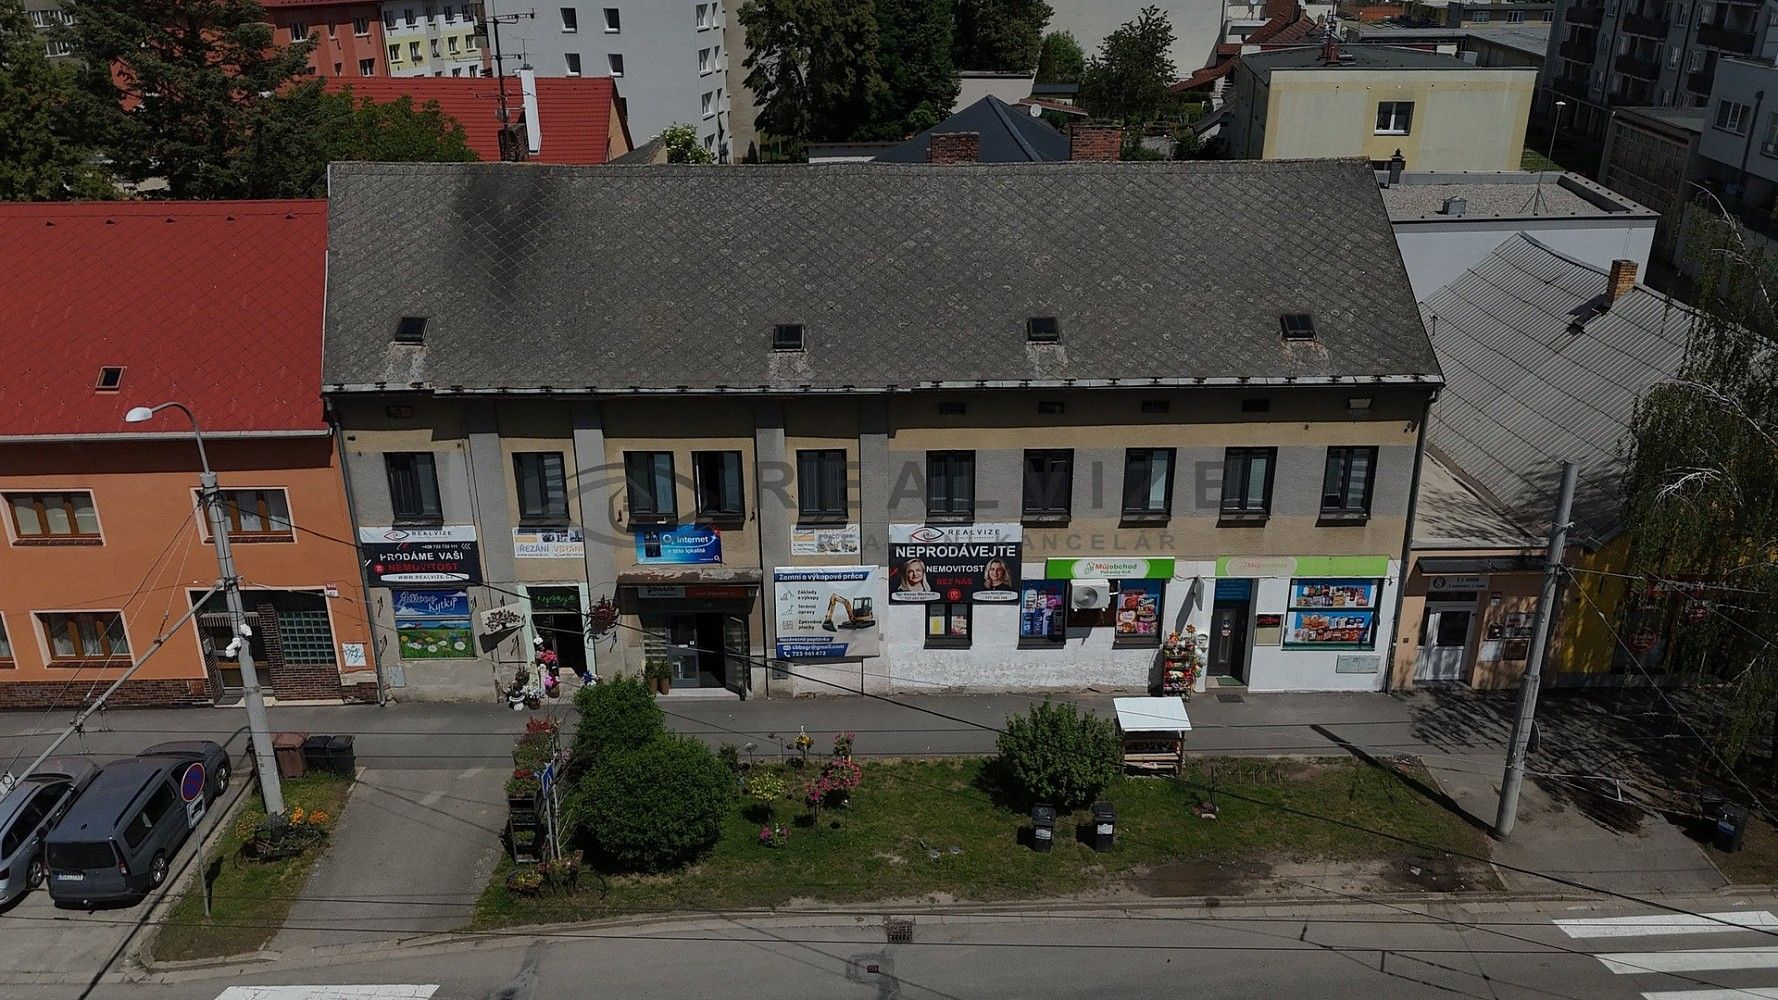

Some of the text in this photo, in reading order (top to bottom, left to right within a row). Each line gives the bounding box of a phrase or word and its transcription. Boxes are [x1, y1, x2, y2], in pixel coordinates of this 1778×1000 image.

[676, 535, 709, 543] Internet
[519, 543, 550, 553] ŘEZÁNÍ
[895, 543, 1016, 557] NEPRODÁVEJTE
[380, 550, 463, 561] PRODÁME VAŠI
[388, 562, 459, 572] NEMOVITOST
[926, 565, 985, 573] NEMOVITOST
[807, 573, 842, 581] výkopové
[843, 572, 864, 580] práce
